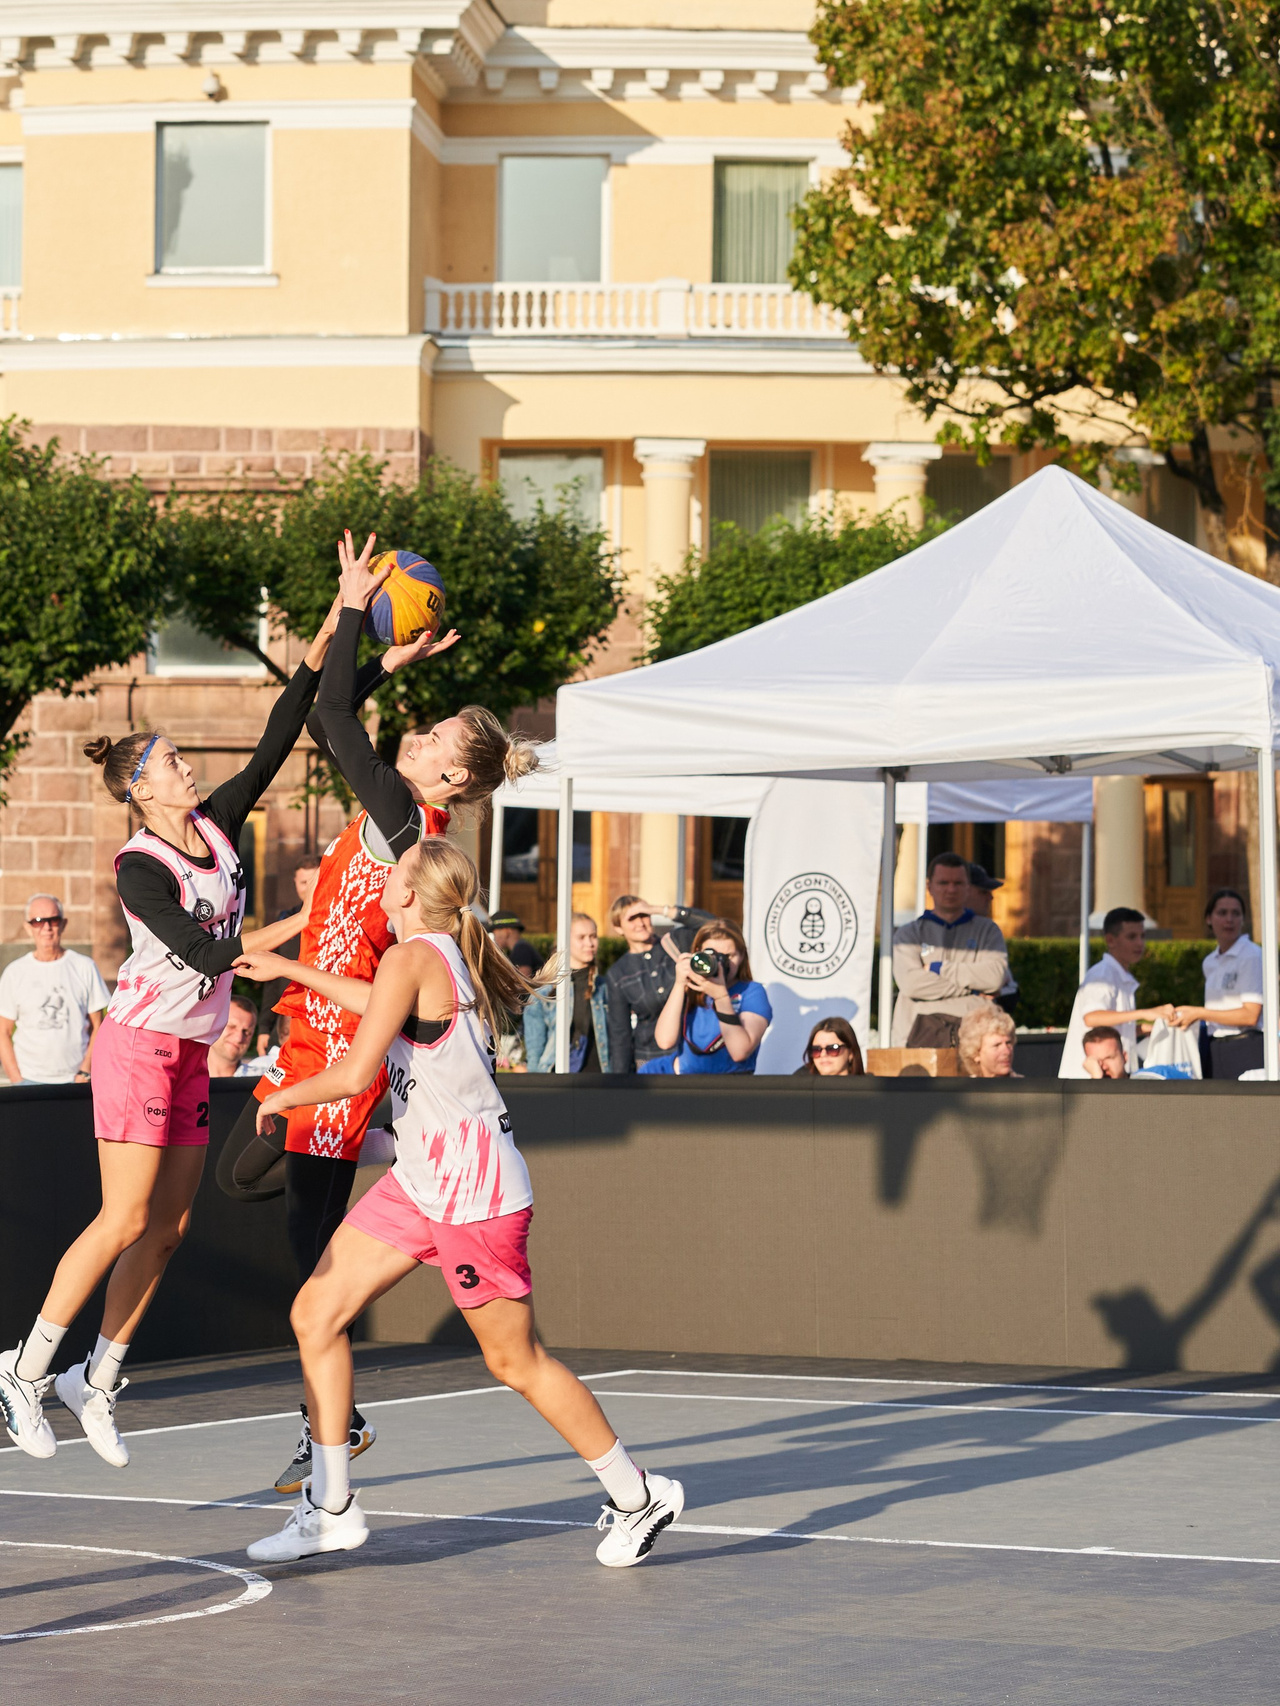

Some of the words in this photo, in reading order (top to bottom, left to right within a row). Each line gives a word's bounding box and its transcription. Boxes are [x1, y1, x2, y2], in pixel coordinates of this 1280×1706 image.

[770, 889, 791, 934] UNITED
[794, 878, 852, 932] CONTINENTAL
[777, 954, 821, 975] LEAGUE
[154, 1048, 172, 1058] ZEDO
[147, 1107, 167, 1117] РФБ
[196, 1101, 209, 1128] 2
[455, 1264, 480, 1290] 3
